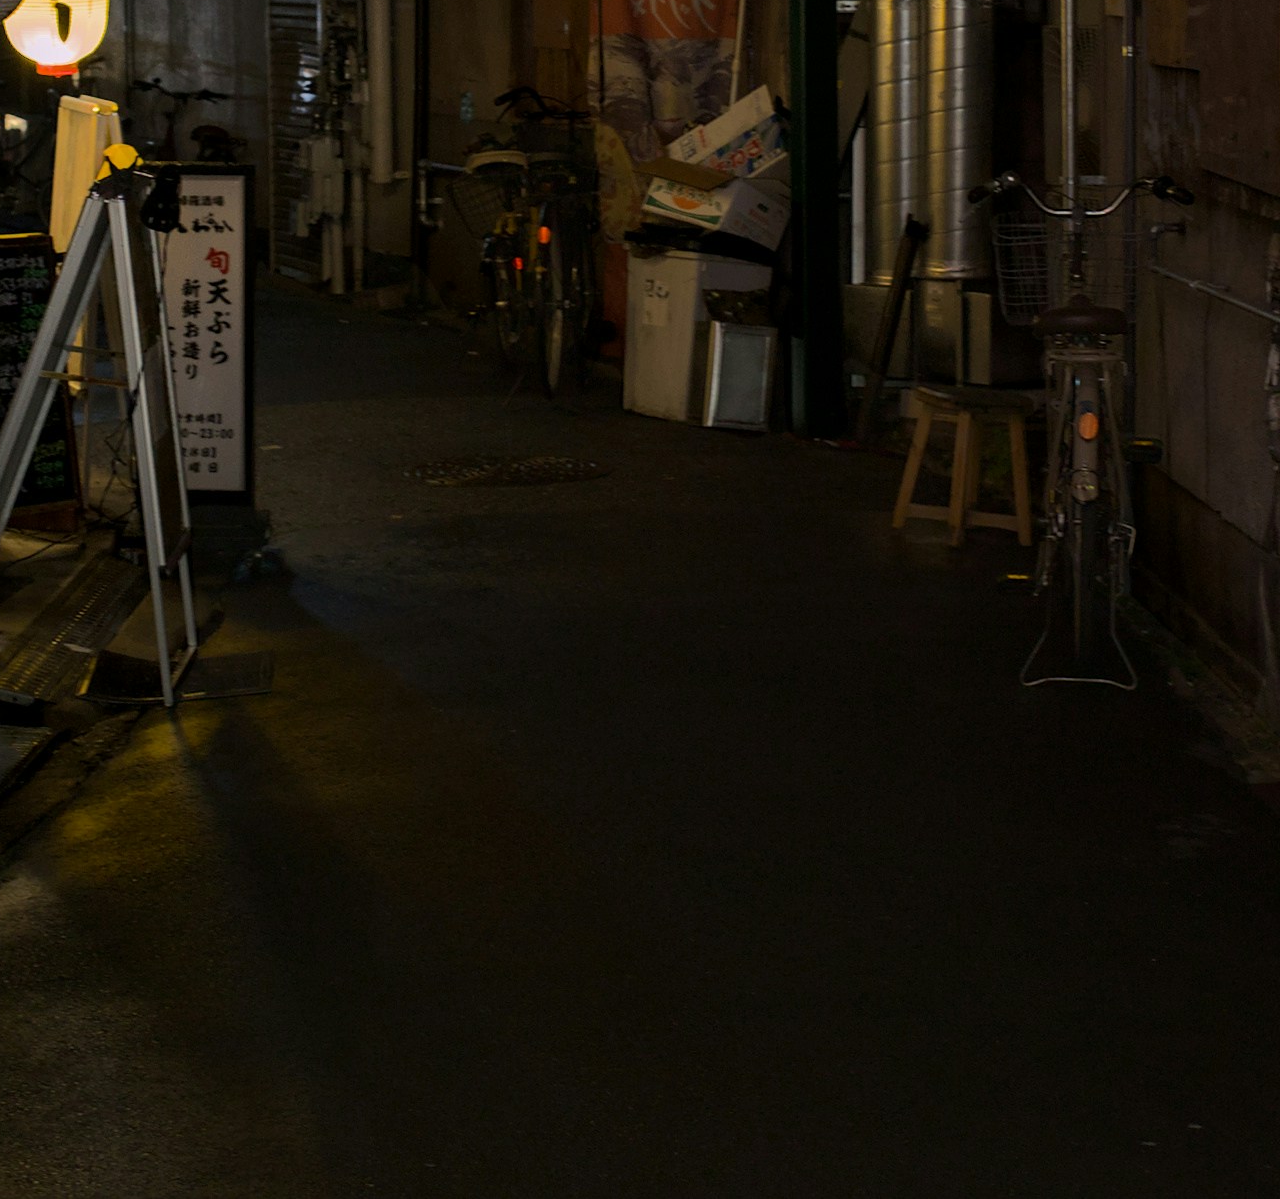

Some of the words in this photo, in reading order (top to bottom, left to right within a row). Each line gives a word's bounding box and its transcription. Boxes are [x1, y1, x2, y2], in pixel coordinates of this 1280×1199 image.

[181, 277, 202, 380] 新鮮お造り
